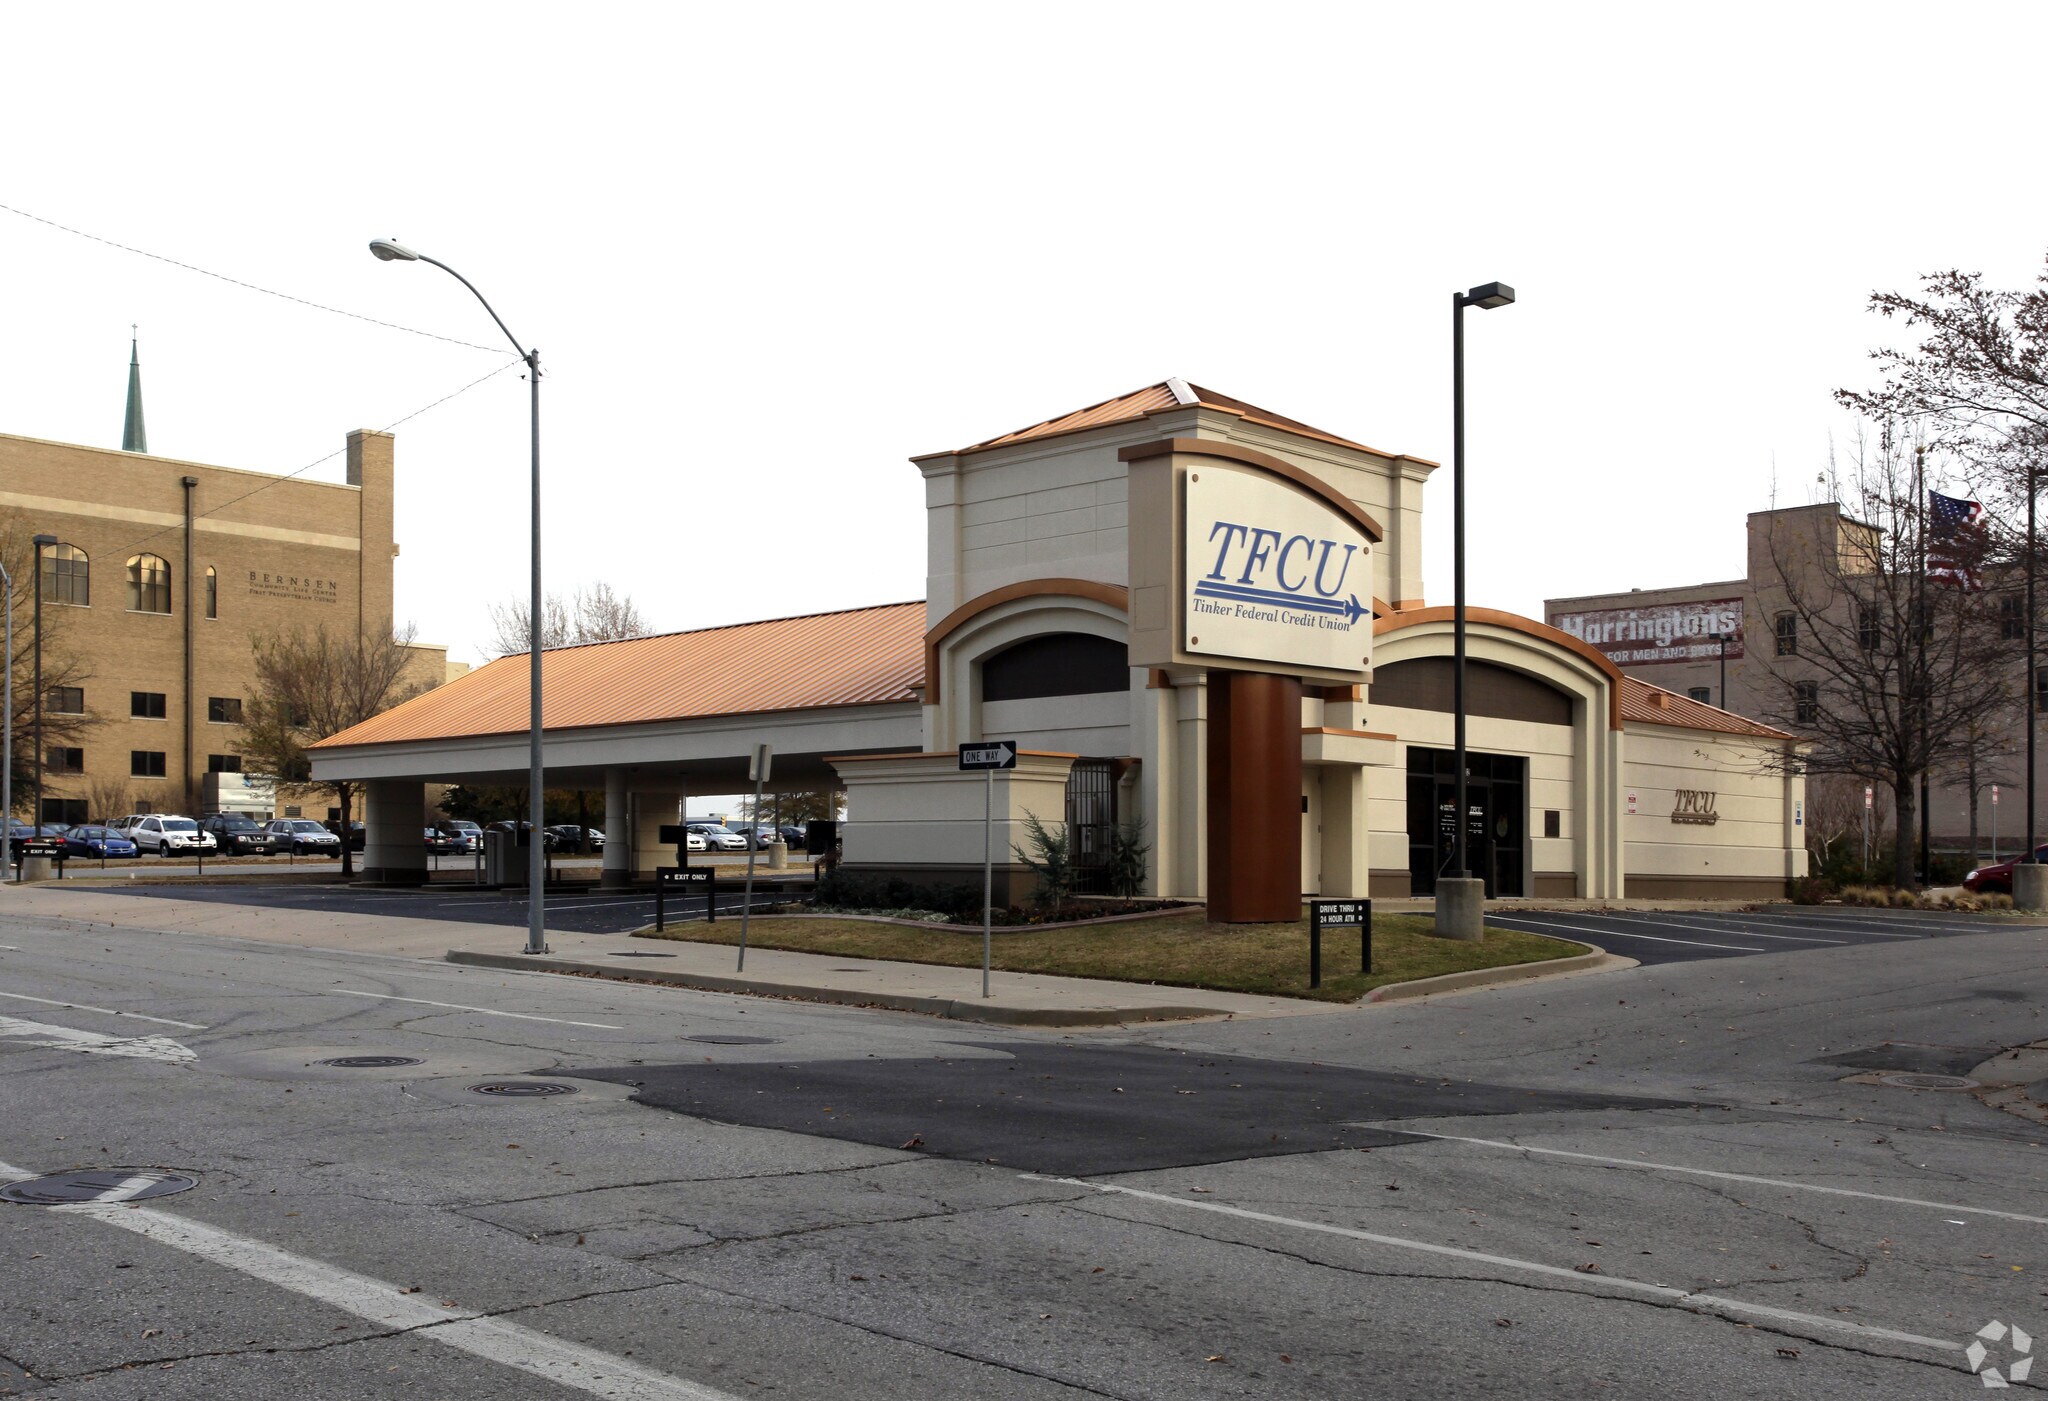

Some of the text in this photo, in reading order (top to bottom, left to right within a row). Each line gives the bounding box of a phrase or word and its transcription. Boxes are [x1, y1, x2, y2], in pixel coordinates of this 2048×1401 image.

[1206, 521, 1358, 597] TFCU
[249, 571, 337, 590] BERNSEN
[1193, 598, 1351, 632] Tinker Federal Credit Union
[1562, 610, 1737, 647] Harringtons
[1607, 650, 1629, 663] FOR
[1633, 649, 1660, 661] MEN
[1662, 646, 1687, 659] AND
[966, 750, 999, 762] ONE WAY
[1674, 789, 1717, 813] TFCU
[1319, 904, 1355, 913] DRIVE THRU
[1319, 914, 1355, 924] 24 HOUR ATM
